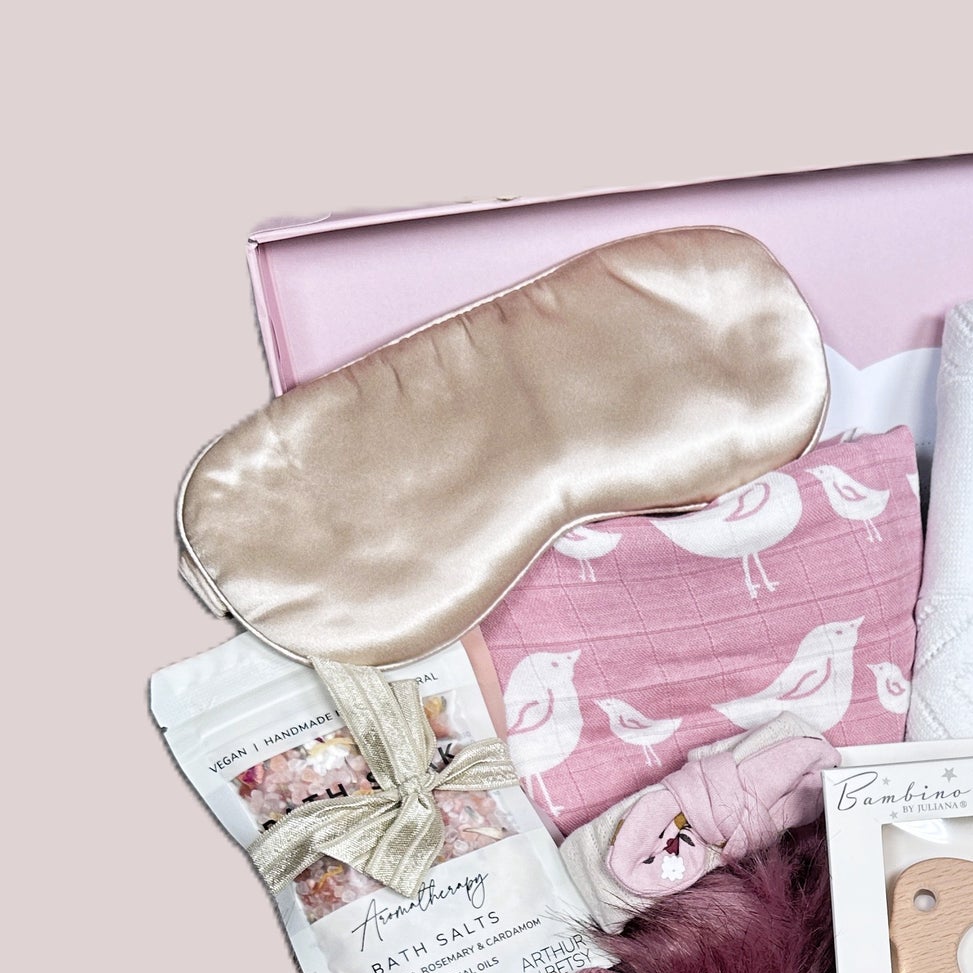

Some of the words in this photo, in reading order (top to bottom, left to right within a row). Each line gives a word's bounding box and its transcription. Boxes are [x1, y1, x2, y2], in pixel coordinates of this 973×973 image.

[209, 747, 248, 774] VEGAN
[263, 712, 333, 746] HANDMADE
[834, 771, 972, 812] Bambino
[902, 804, 916, 814] BY
[352, 872, 489, 952] Aromatherapy
[436, 911, 500, 946] SALTS
[420, 947, 475, 973] ROSEMARY
[477, 941, 485, 951] &
[486, 918, 541, 948] CARDAMOM
[477, 956, 500, 972] OILS
[522, 934, 587, 973] ARTHUR
